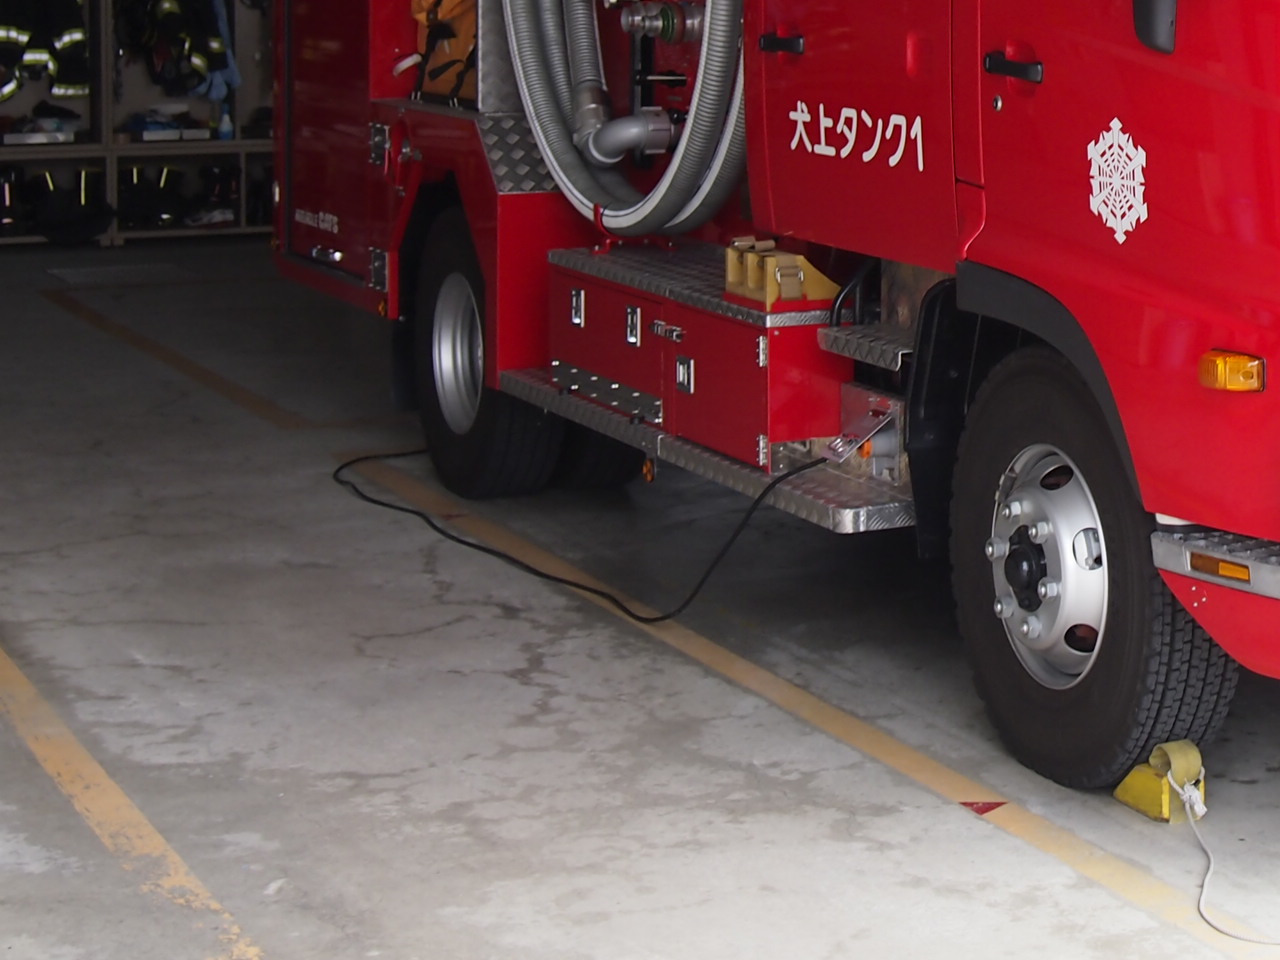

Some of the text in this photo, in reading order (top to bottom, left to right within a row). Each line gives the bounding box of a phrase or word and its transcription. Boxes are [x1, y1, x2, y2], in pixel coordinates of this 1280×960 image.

[788, 99, 926, 173] 犬上タンク1
